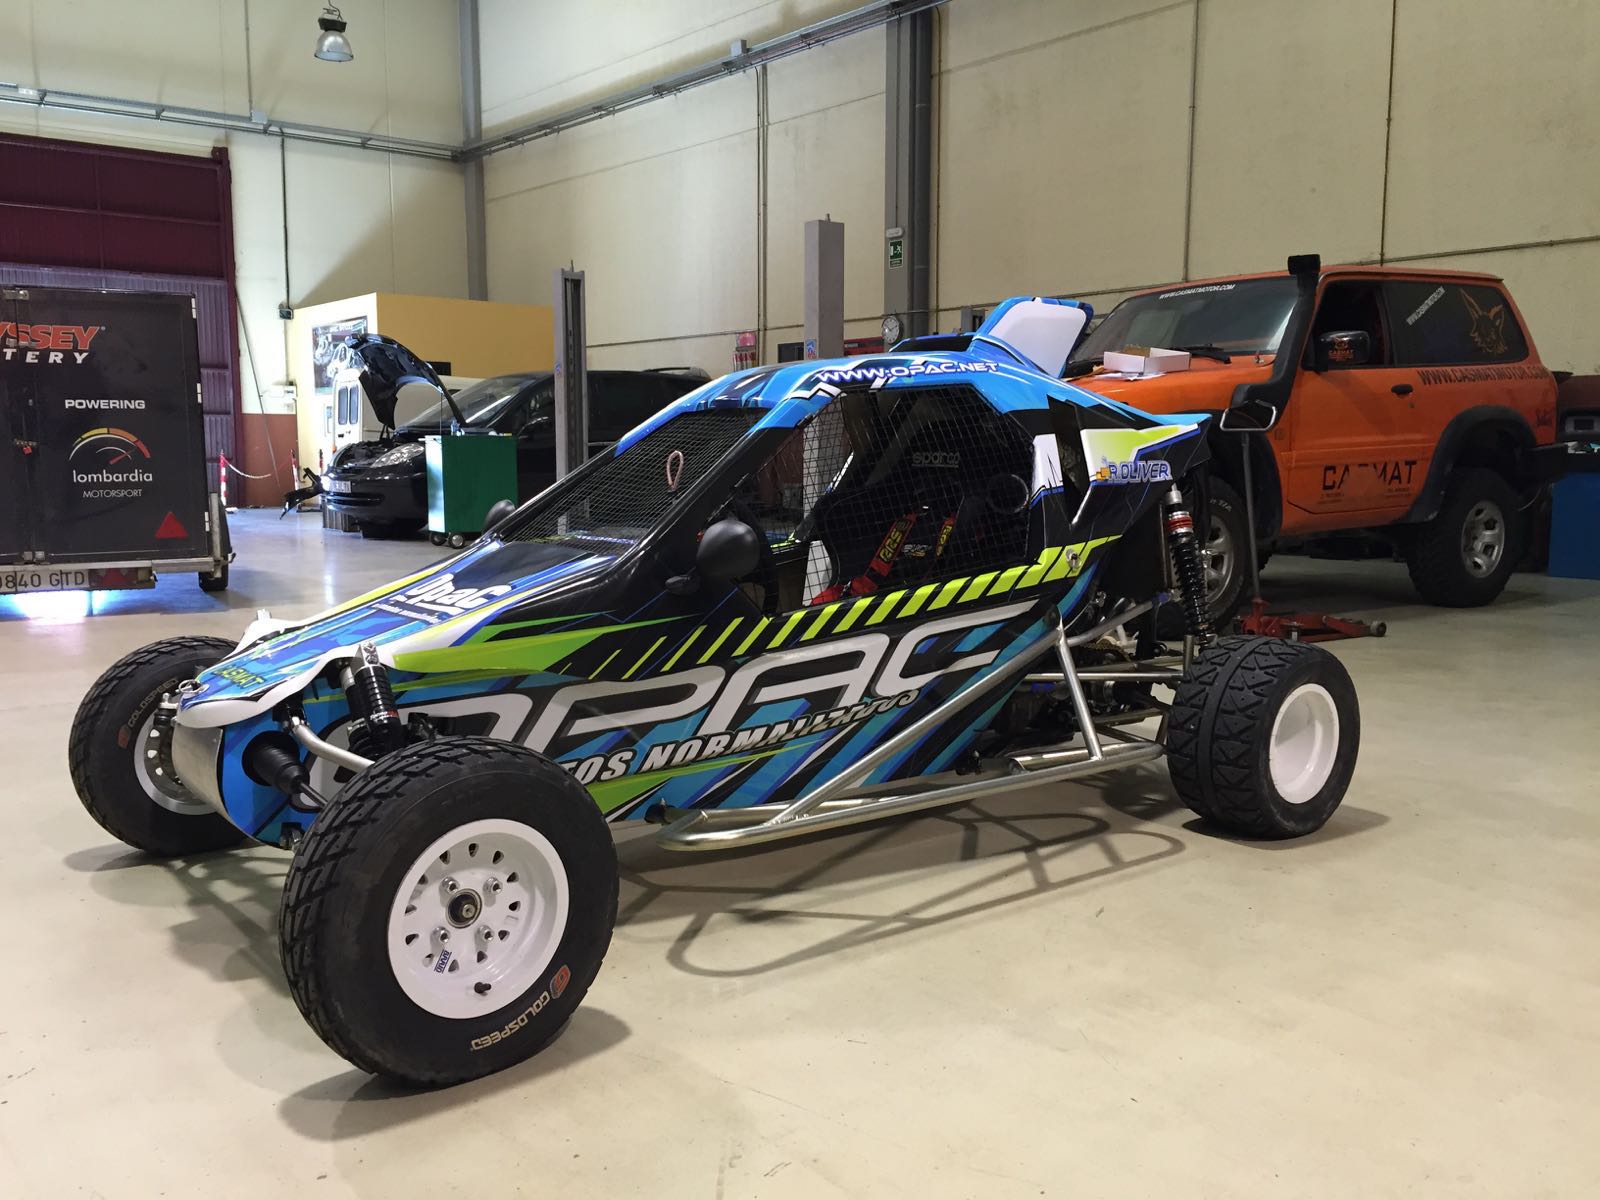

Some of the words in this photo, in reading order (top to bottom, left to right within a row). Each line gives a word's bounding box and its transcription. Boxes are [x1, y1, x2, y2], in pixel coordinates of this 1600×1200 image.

[65, 399, 146, 409] POWERING
[73, 469, 152, 483] lombardia
[82, 488, 142, 498] MOTORSPORT
[0, 574, 41, 589] 840
[49, 571, 84, 588] GTD
[471, 990, 550, 1050] GOLDSPEED
